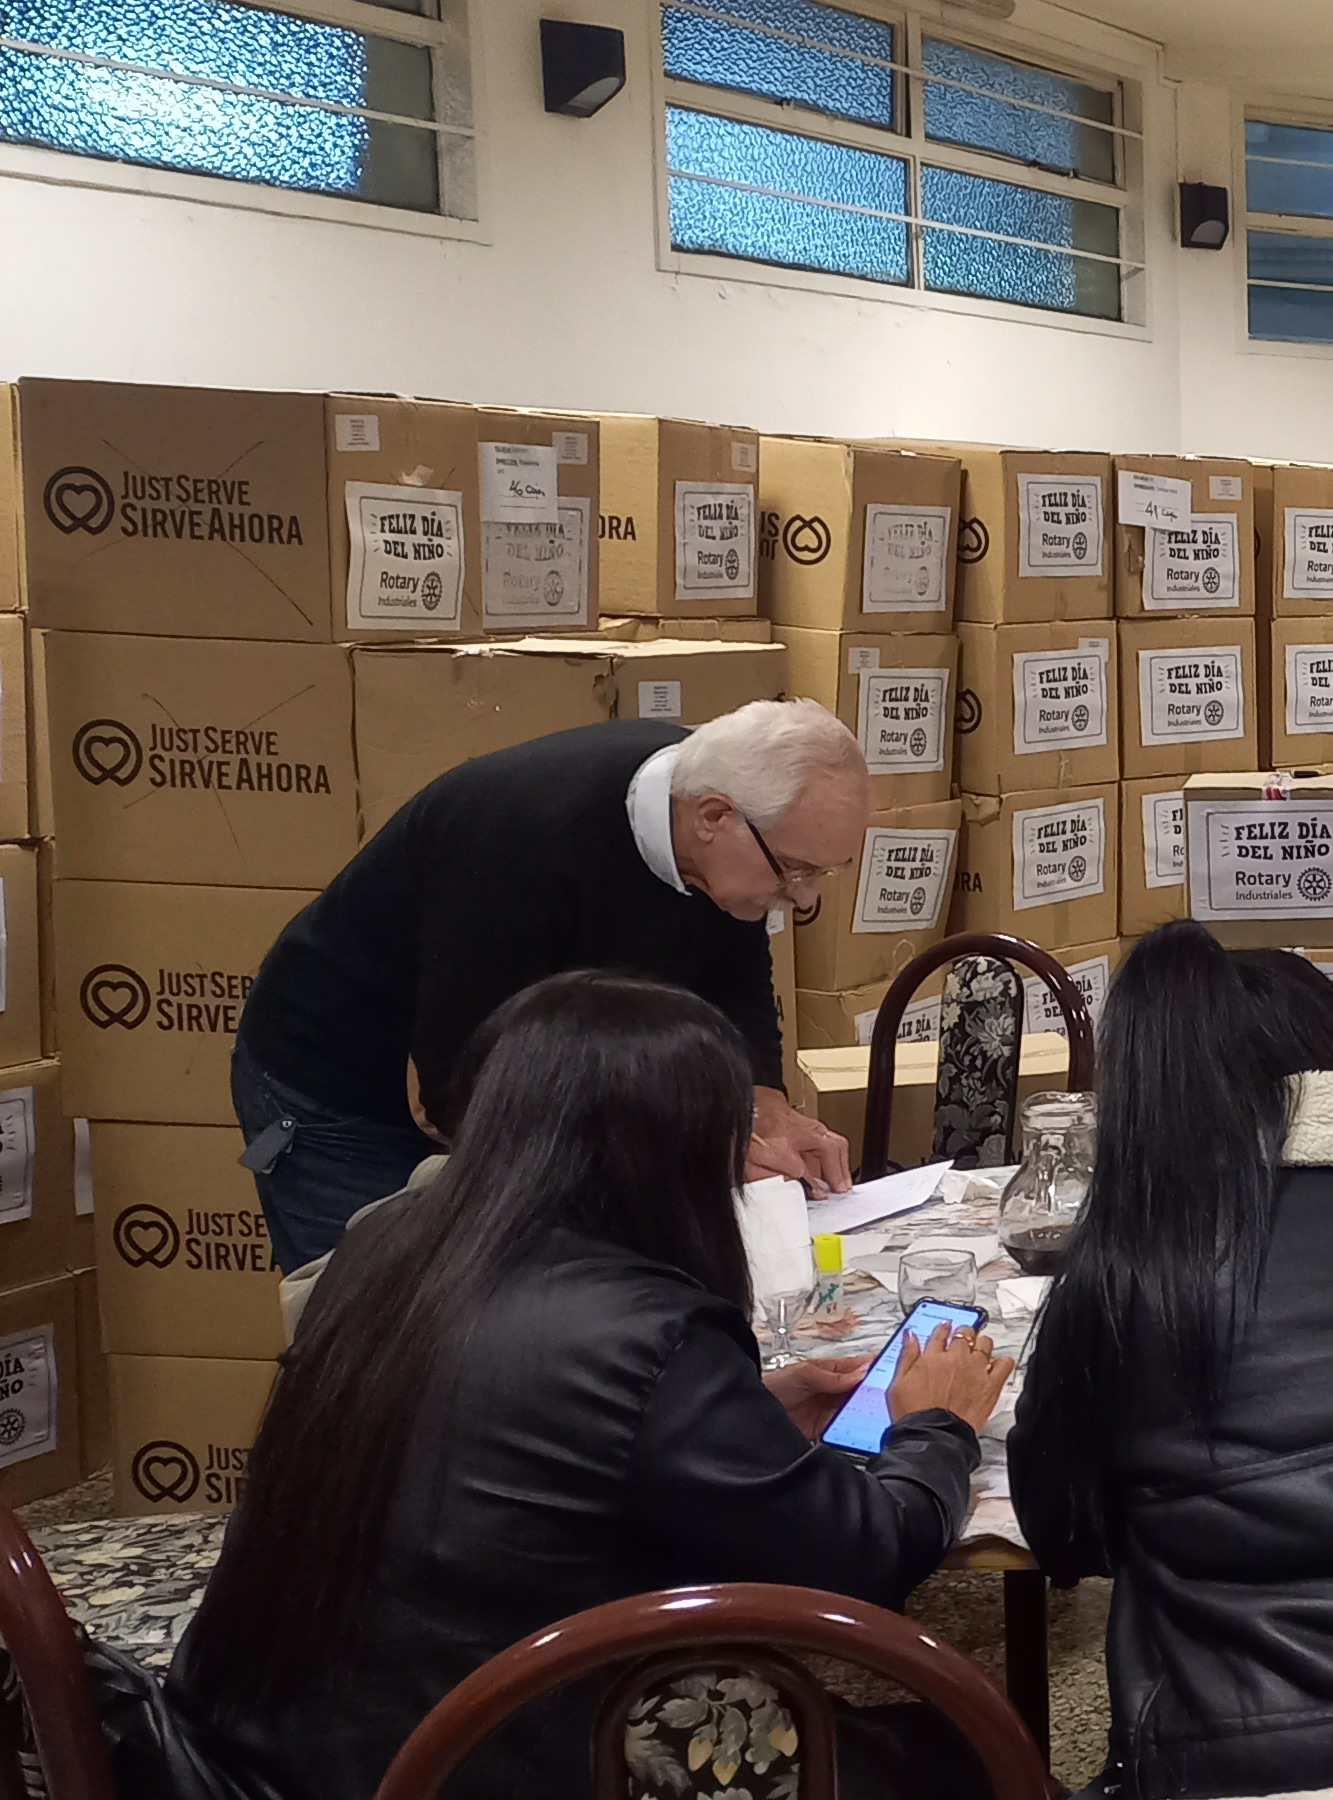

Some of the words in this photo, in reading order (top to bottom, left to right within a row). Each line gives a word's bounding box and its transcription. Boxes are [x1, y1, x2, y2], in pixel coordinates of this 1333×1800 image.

[1041, 492, 1068, 507] FELIZ
[380, 513, 417, 535] FELIZ
[1043, 511, 1062, 524] DEL
[1065, 508, 1087, 525] NIÑO
[1042, 533, 1071, 549] Rotary
[1167, 530, 1198, 545] FELIZ
[383, 540, 408, 559] DEL
[412, 538, 445, 560] NIÑO
[1169, 547, 1189, 560] DEL
[1193, 544, 1220, 561] NIÑO
[1309, 541, 1328, 553] DEL
[380, 571, 420, 594] Rotary
[1167, 568, 1200, 583] Rotary
[1038, 667, 1068, 684] FELIZ
[1167, 664, 1200, 680] FELIZ
[1041, 687, 1060, 699] DEL
[1064, 681, 1088, 699] NIÑO
[1169, 682, 1191, 694] DEL
[1196, 679, 1223, 695] NIÑO
[1311, 677, 1330, 688] DEL
[881, 686, 910, 703] FELIZ
[882, 705, 900, 720] DEL
[904, 703, 928, 720] NIÑO
[1039, 709, 1070, 722] Rotary
[1167, 704, 1202, 717] Rotary
[880, 729, 908, 745] Rotary
[1037, 820, 1067, 839] FELIZ
[1234, 822, 1290, 840] FELIZ
[1297, 817, 1332, 840] DÍA
[1038, 841, 1058, 853] DEL
[1062, 833, 1087, 852] NIÑO
[1237, 845, 1273, 860] DEL
[1281, 840, 1330, 860] NIÑO
[886, 847, 918, 862] FELIZ
[885, 865, 906, 880] DEL
[908, 863, 932, 880] NIÑO
[1036, 863, 1067, 877] Rotary
[1235, 871, 1291, 888] Rotary
[879, 888, 910, 904] Rotary
[1236, 890, 1293, 900] Industriales
[156, 969, 255, 999] JUSTSER
